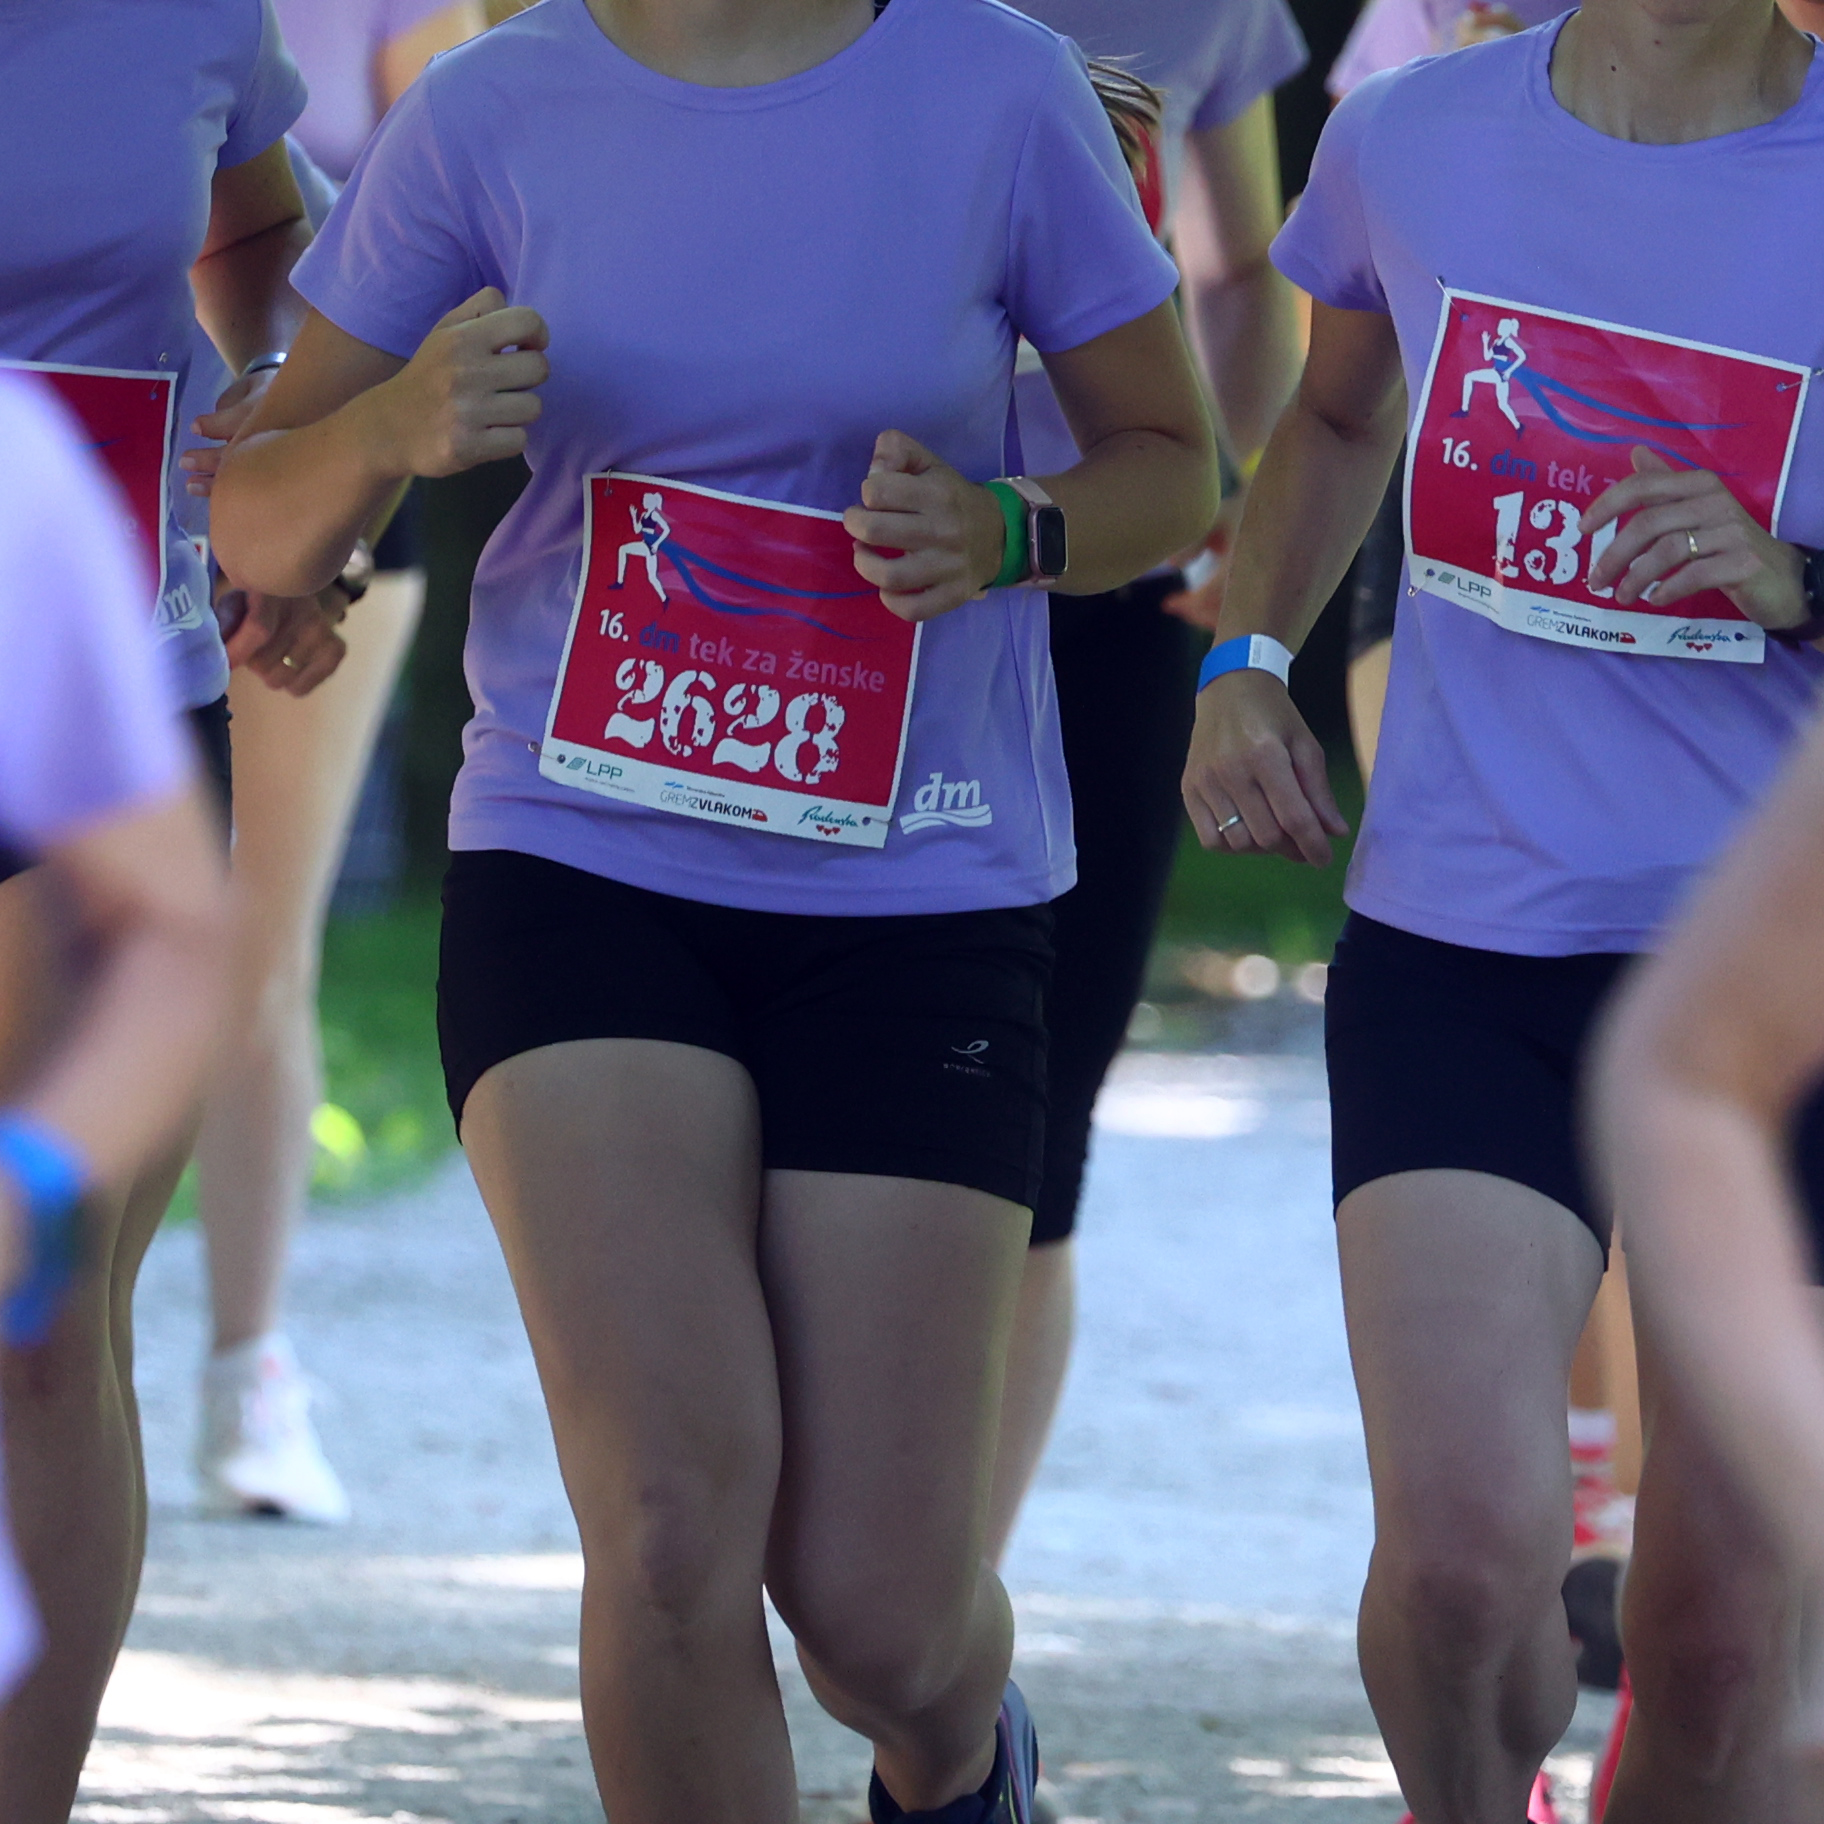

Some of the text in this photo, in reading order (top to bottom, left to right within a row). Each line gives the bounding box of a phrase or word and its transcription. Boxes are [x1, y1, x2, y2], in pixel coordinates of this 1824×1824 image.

[1442, 437, 1594, 495] 16. dm tek
[1457, 577, 1492, 598] LPP
[599, 609, 885, 693] 16. dm tek za ženske
[605, 658, 845, 784] 2628
[587, 760, 623, 780] LPP
[914, 772, 980, 812] dm
